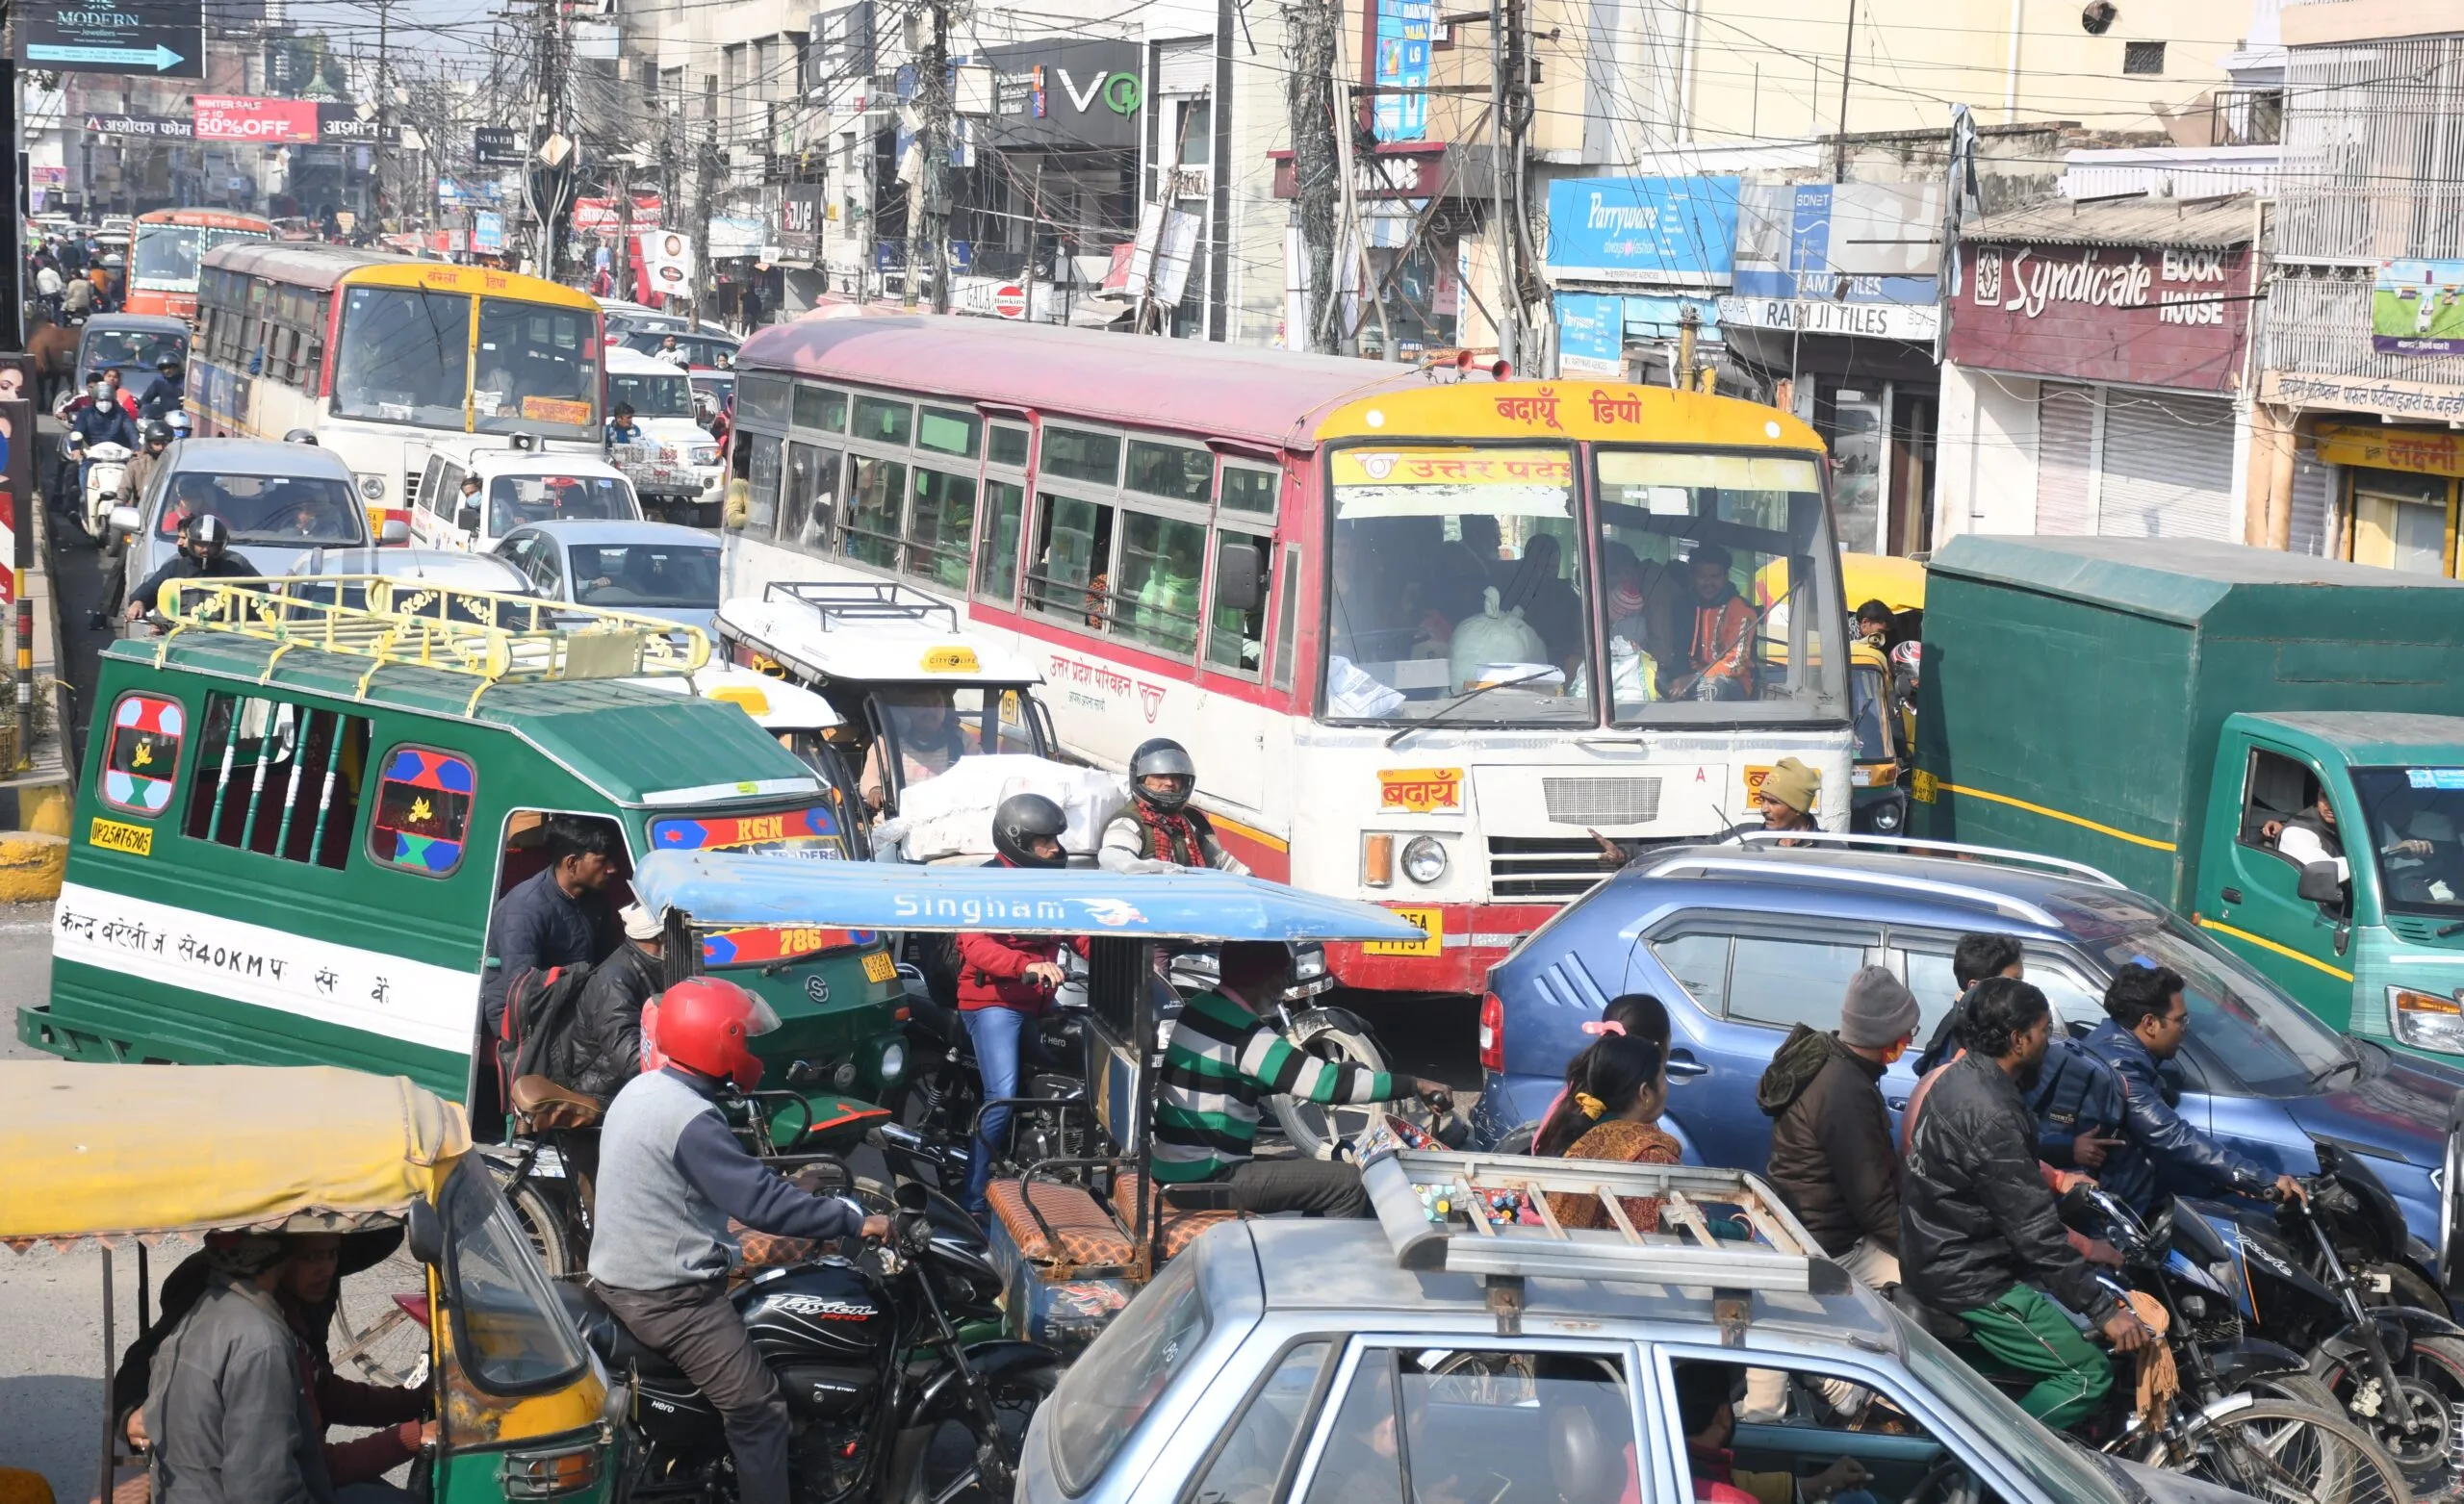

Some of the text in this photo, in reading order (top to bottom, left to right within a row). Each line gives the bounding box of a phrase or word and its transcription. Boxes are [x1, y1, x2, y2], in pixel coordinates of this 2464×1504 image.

[58, 12, 139, 26] MODERN
[1409, 45, 1421, 63] LG
[196, 99, 262, 111] WINTER SALE
[103, 116, 192, 136] अशोका फोम
[1796, 194, 1829, 206] SONET
[1587, 191, 1658, 238] Parryware
[2006, 246, 2224, 319] Syndicate BOOK
[966, 282, 990, 310] GALA
[1766, 302, 1810, 328] RAM
[1816, 305, 1829, 328] JI
[1838, 308, 1887, 334] TILES
[2160, 291, 2224, 324] HOUSE
[1495, 387, 1642, 431] बदायूँ डिपो
[2387, 435, 2457, 472] लक्ष्मी
[1409, 460, 1494, 479] उत्तर
[1050, 654, 1132, 699] उत्तर प्रदेश परिवहन
[1696, 766, 1706, 782] A
[736, 816, 783, 841] KGN
[893, 893, 1065, 924] Singham
[781, 930, 821, 956] 786
[1047, 1035, 1066, 1047] Hero
[765, 1293, 878, 1314] Passion
[819, 1313, 869, 1321] PRO
[814, 1383, 835, 1391] POWER
[651, 1400, 675, 1414] Hero
